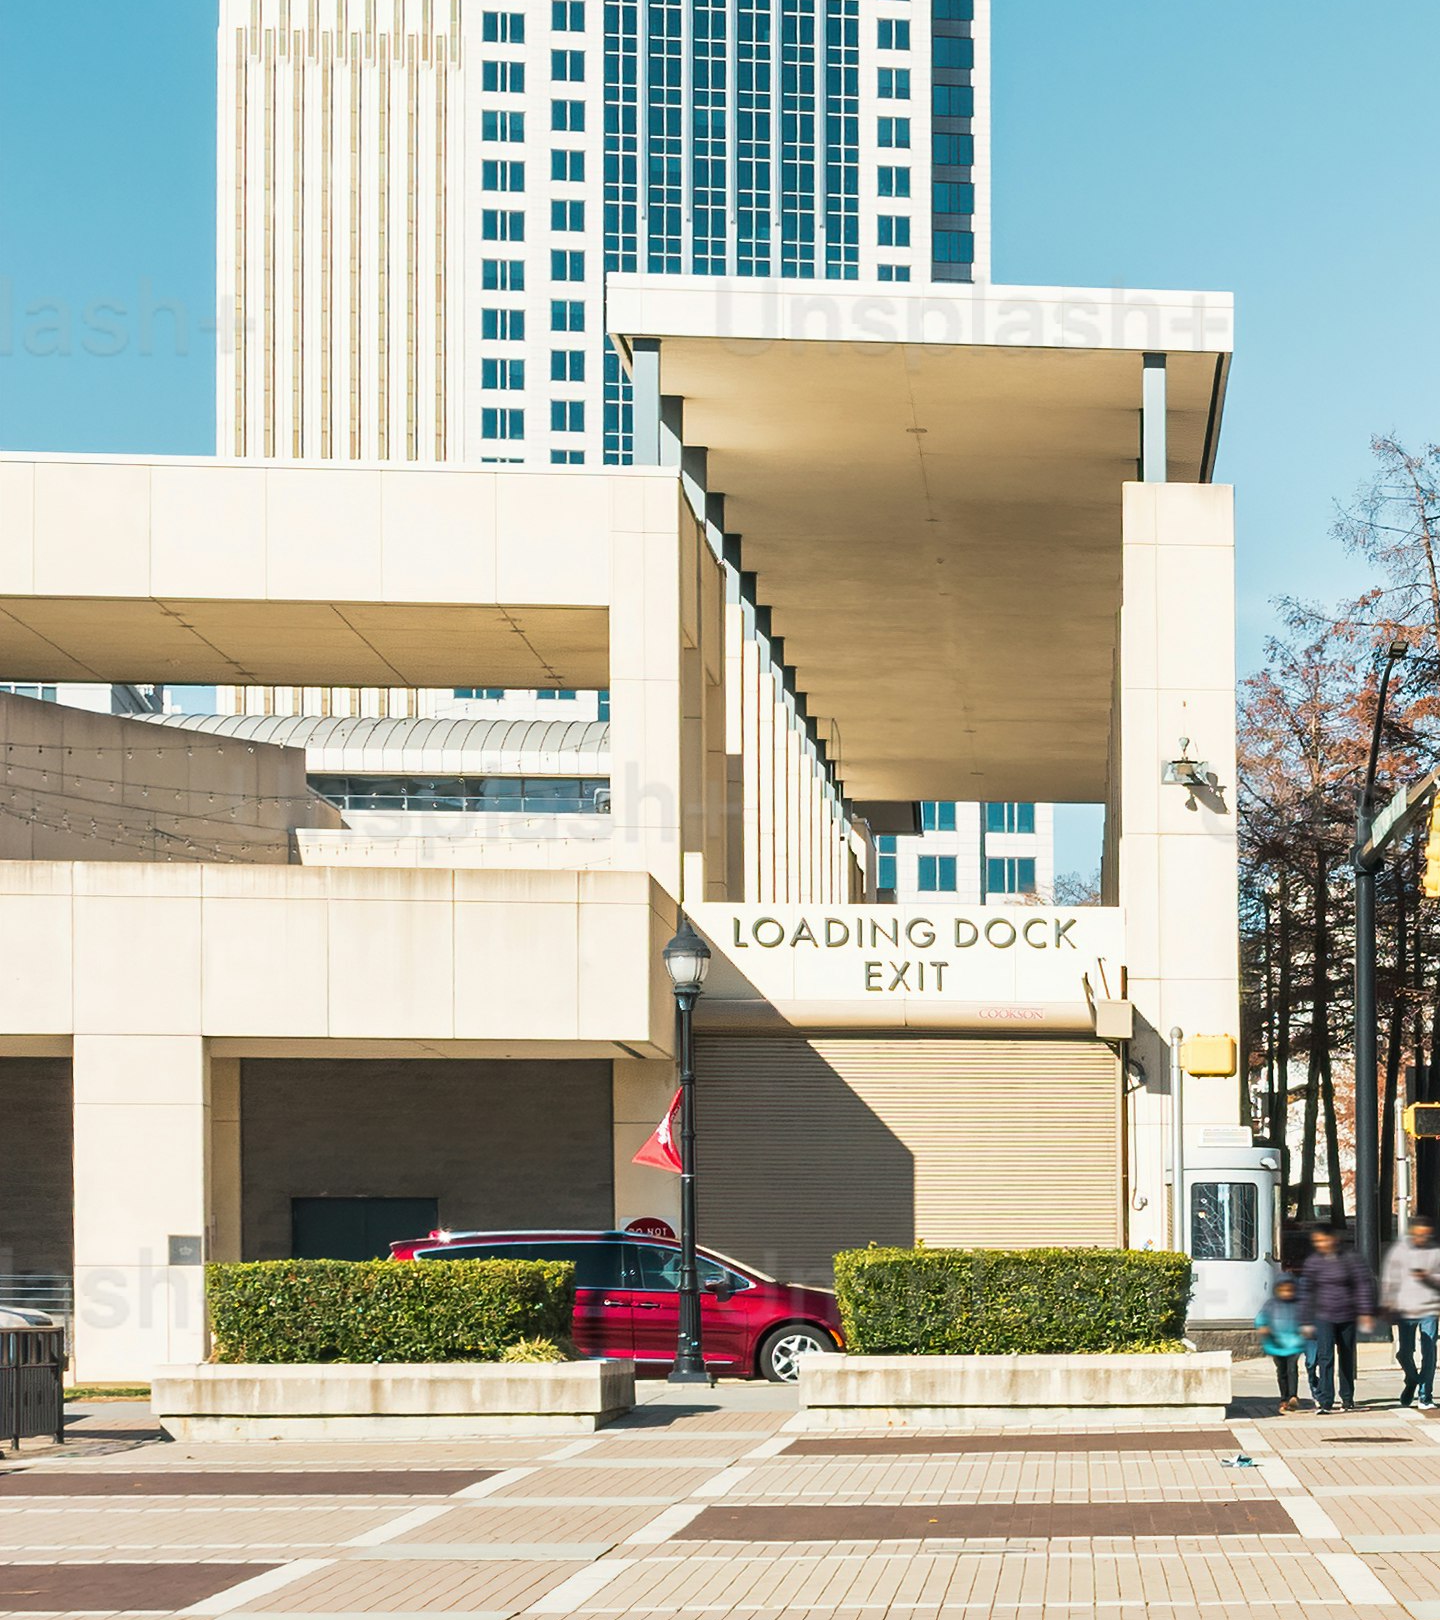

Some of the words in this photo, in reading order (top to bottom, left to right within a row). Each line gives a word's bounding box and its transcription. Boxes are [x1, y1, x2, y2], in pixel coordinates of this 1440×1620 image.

[732, 917, 937, 949] LOADING
[954, 917, 1078, 949] DOCK
[864, 961, 950, 992] EXIT
[979, 1009, 1043, 1019] COOKSON
